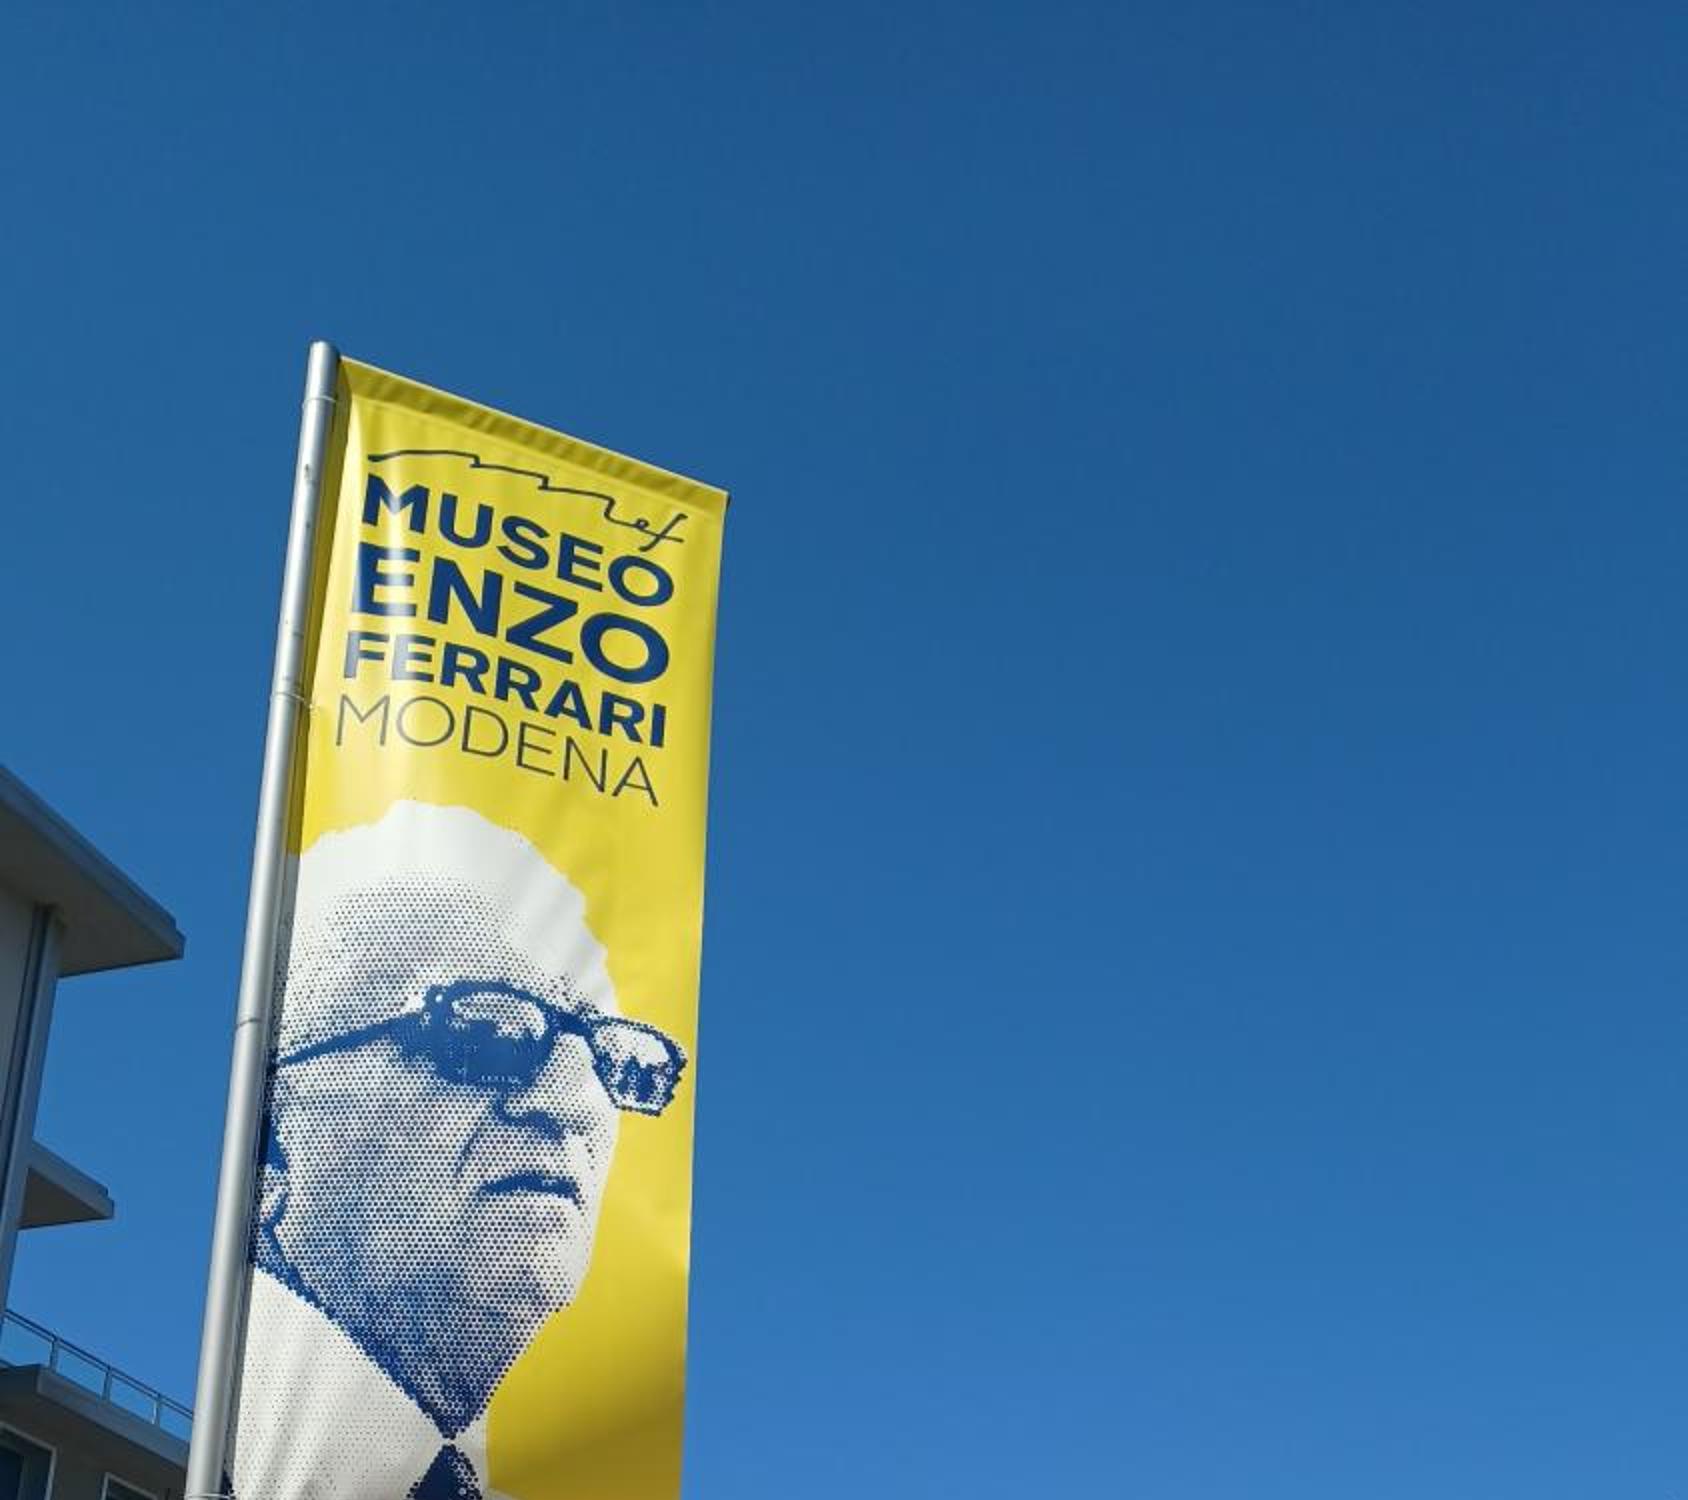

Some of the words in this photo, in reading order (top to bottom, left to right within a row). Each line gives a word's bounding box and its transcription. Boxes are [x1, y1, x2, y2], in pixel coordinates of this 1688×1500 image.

[362, 473, 674, 607] MUSEO
[352, 542, 670, 684] ENZO
[336, 694, 659, 807] MODENA
[344, 631, 667, 748] FERRARI
